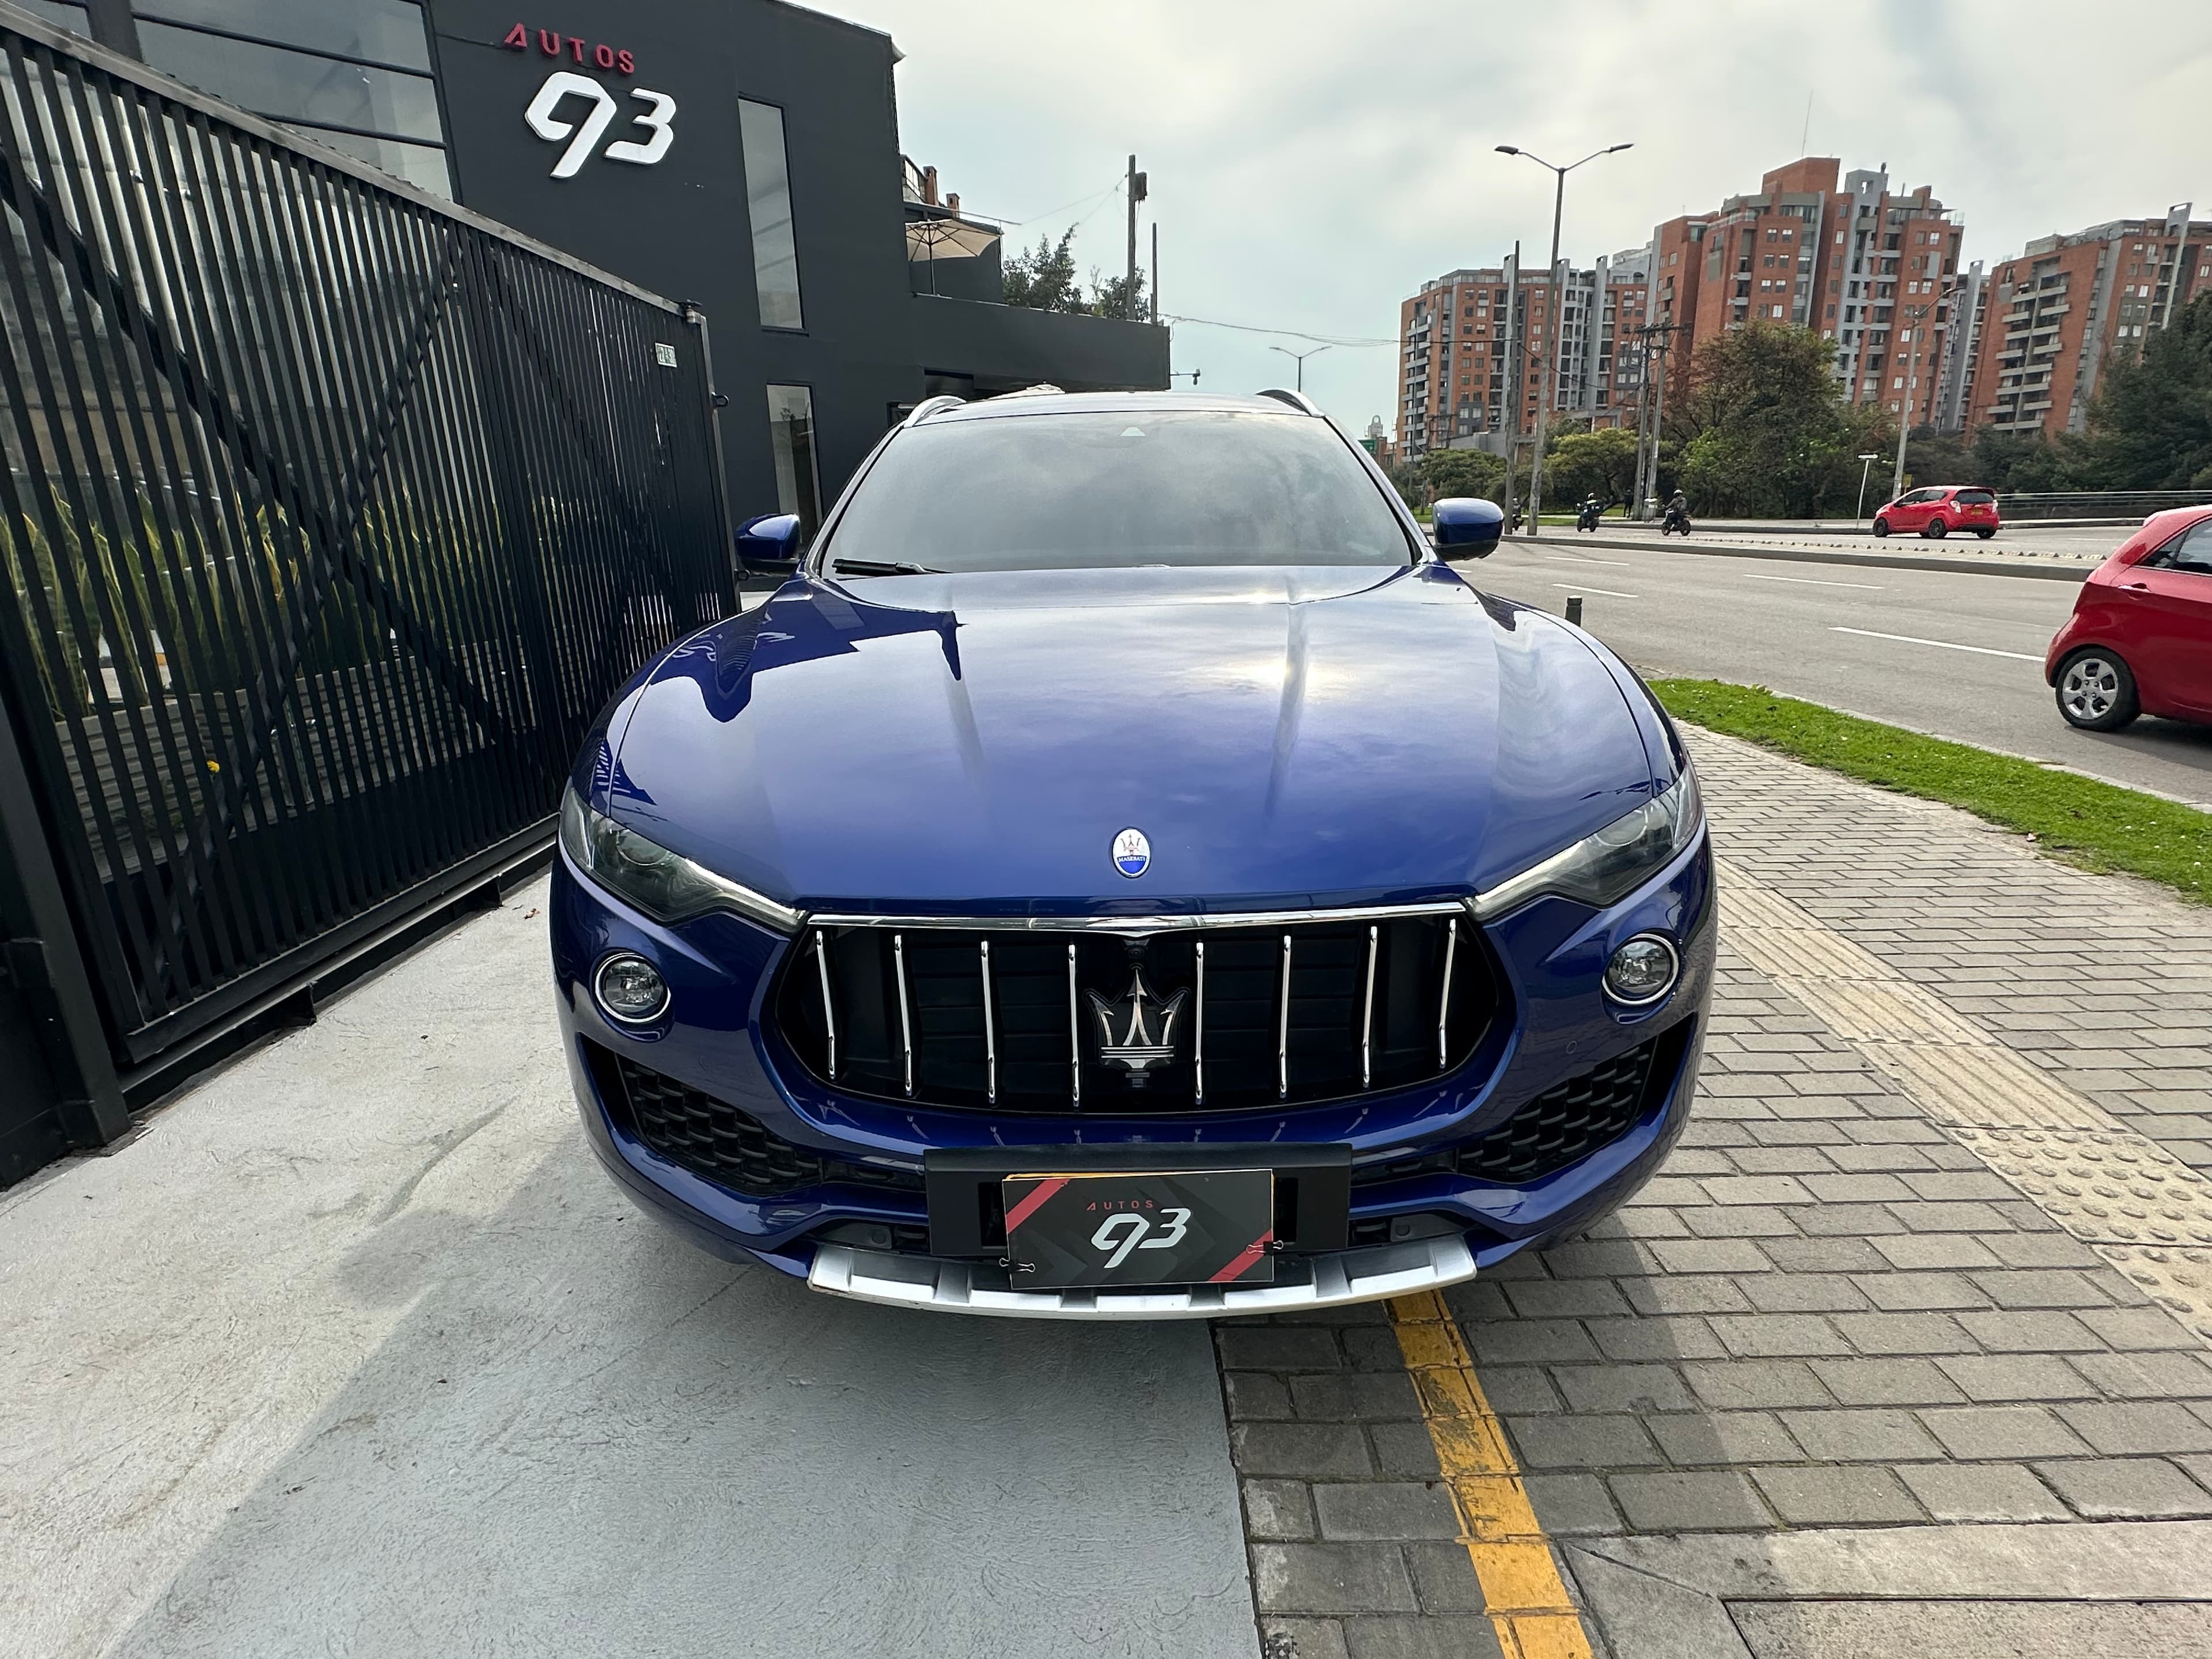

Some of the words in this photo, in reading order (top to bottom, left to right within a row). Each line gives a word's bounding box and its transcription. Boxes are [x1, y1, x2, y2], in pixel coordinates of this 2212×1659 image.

[505, 23, 634, 74] AUTOS
[525, 71, 676, 179] 93
[1086, 1200, 1153, 1211] AUTOS
[1091, 1208, 1191, 1268] 93
